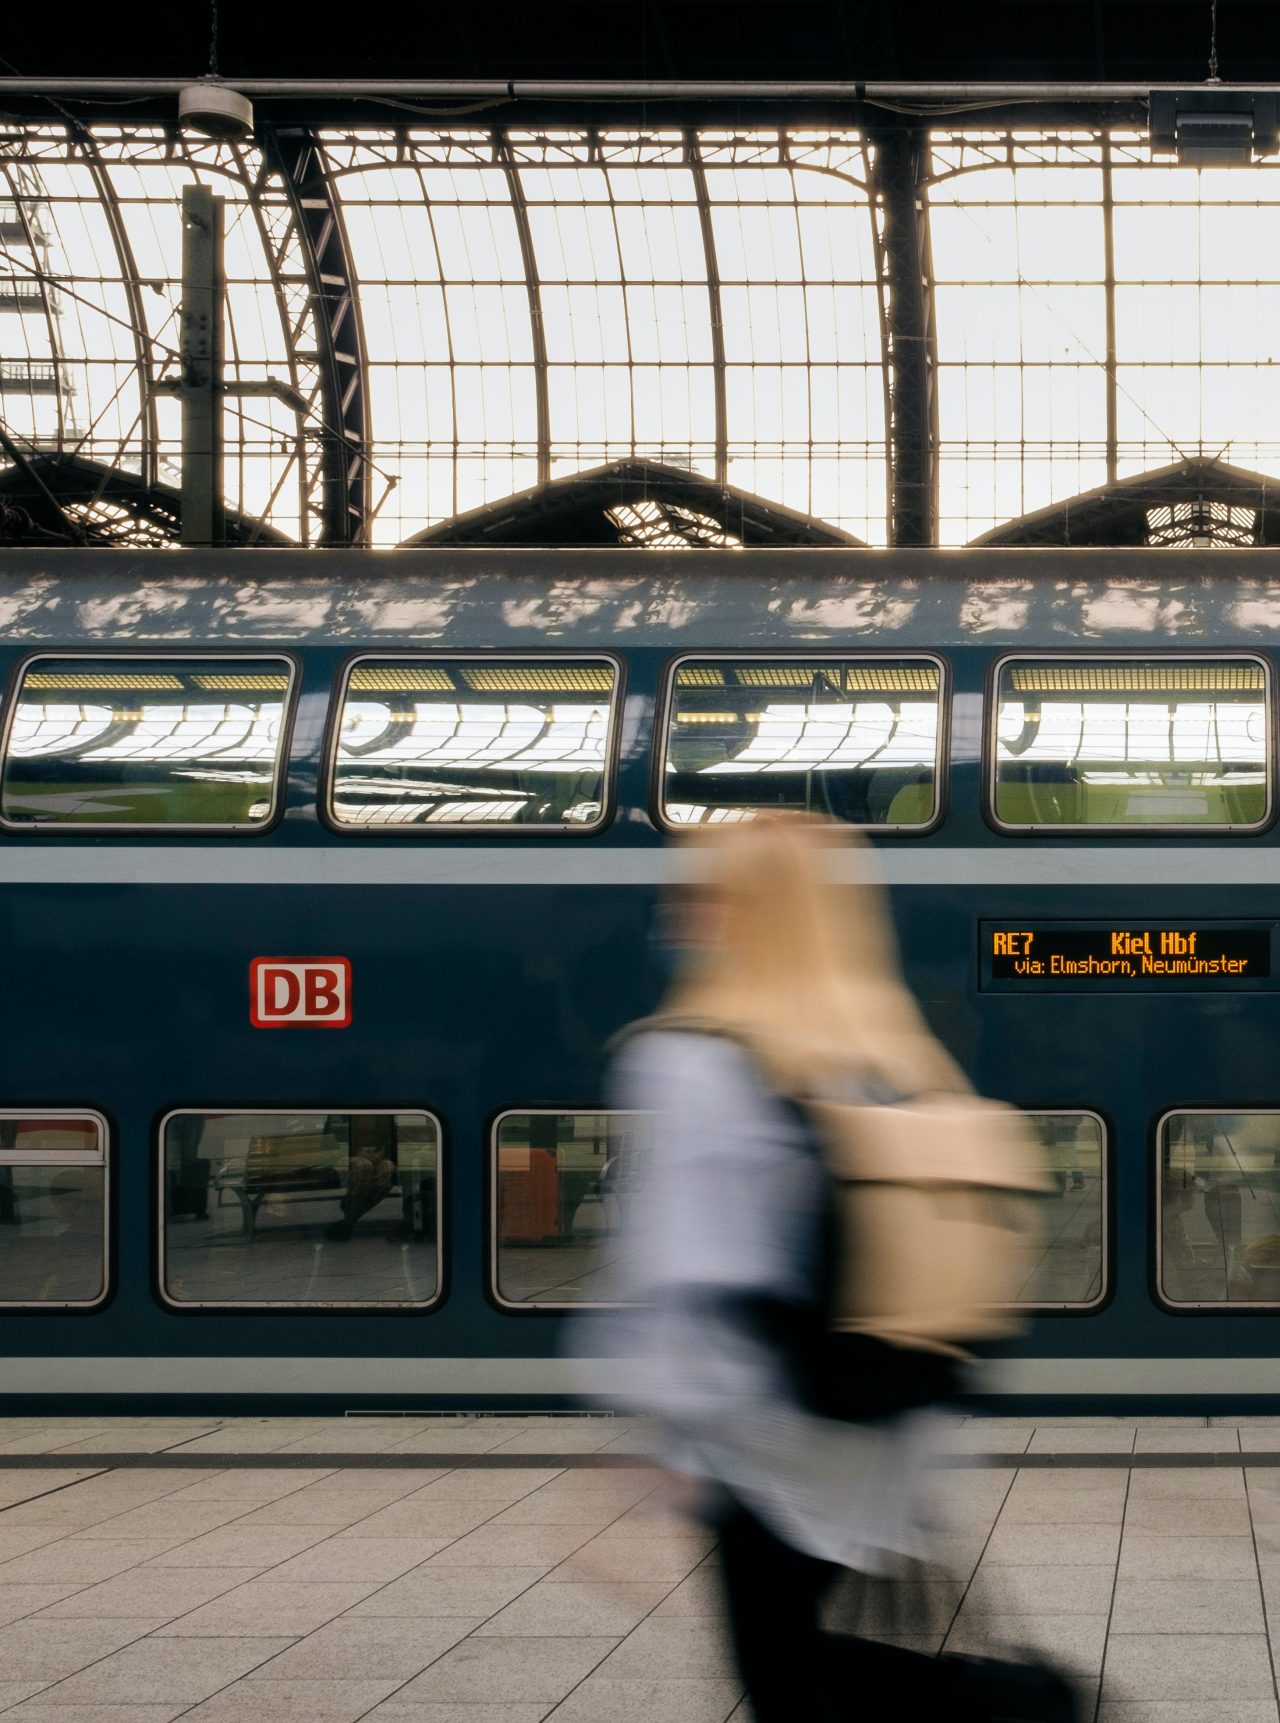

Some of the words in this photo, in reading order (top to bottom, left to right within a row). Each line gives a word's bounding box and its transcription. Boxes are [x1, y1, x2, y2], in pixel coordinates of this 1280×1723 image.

[993, 932, 1034, 955] RE7
[1111, 932, 1153, 955] Kiel
[1160, 932, 1197, 955] Hbf
[1014, 957, 1046, 974] via:
[1050, 954, 1137, 978] Elmshorn,
[1141, 954, 1249, 974] Neumünster
[263, 968, 341, 1017] DB
